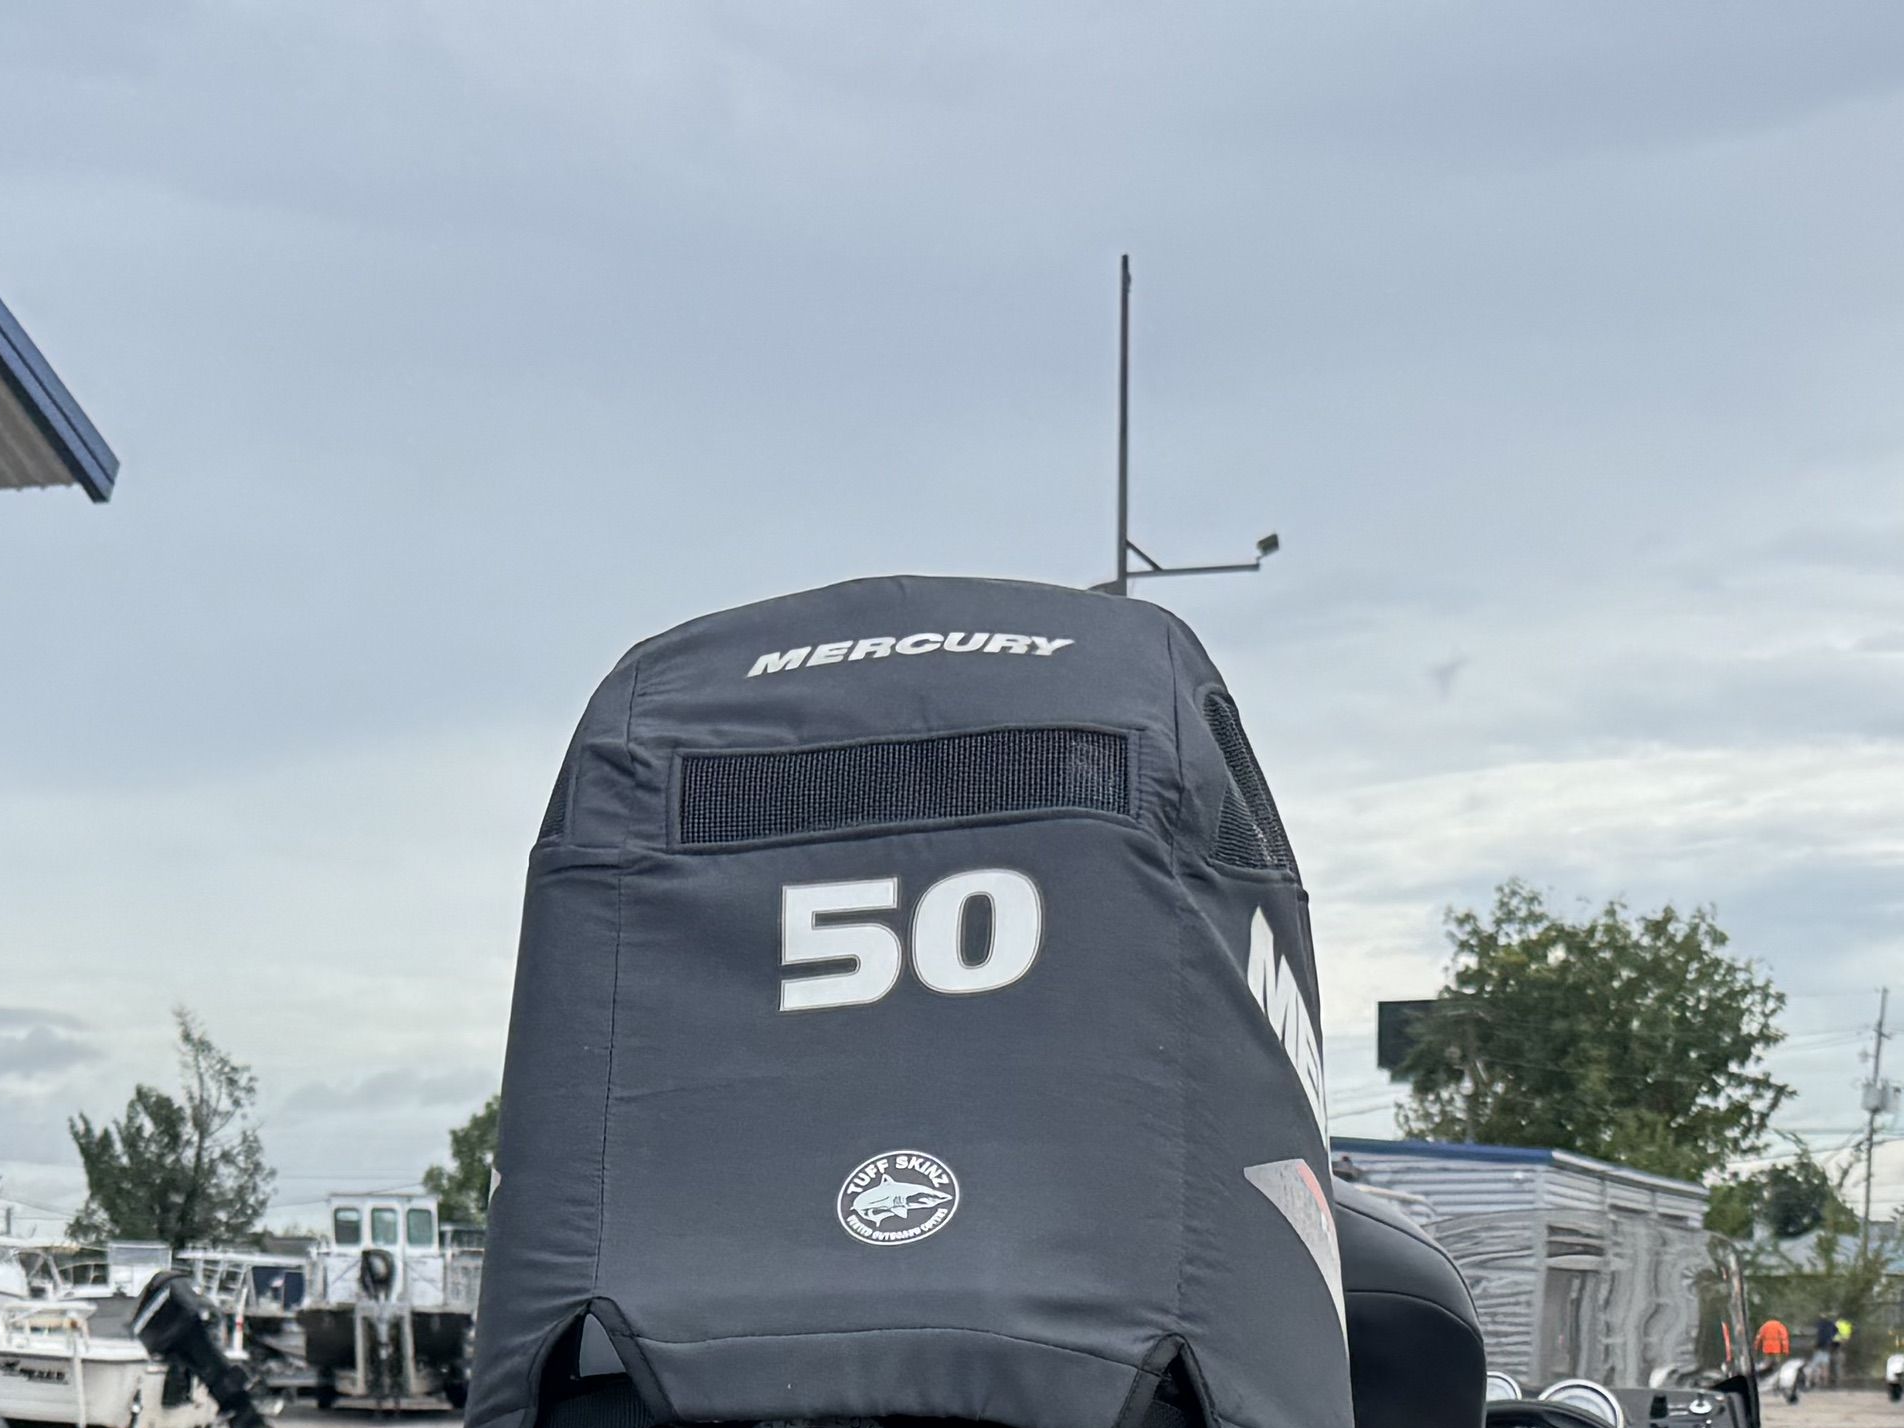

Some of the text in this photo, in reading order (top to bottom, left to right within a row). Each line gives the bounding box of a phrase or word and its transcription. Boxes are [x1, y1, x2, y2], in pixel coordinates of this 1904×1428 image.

[746, 632, 1076, 679] MERCURY
[779, 867, 1043, 1012] 50
[847, 1155, 949, 1195] TUFF SKINZ
